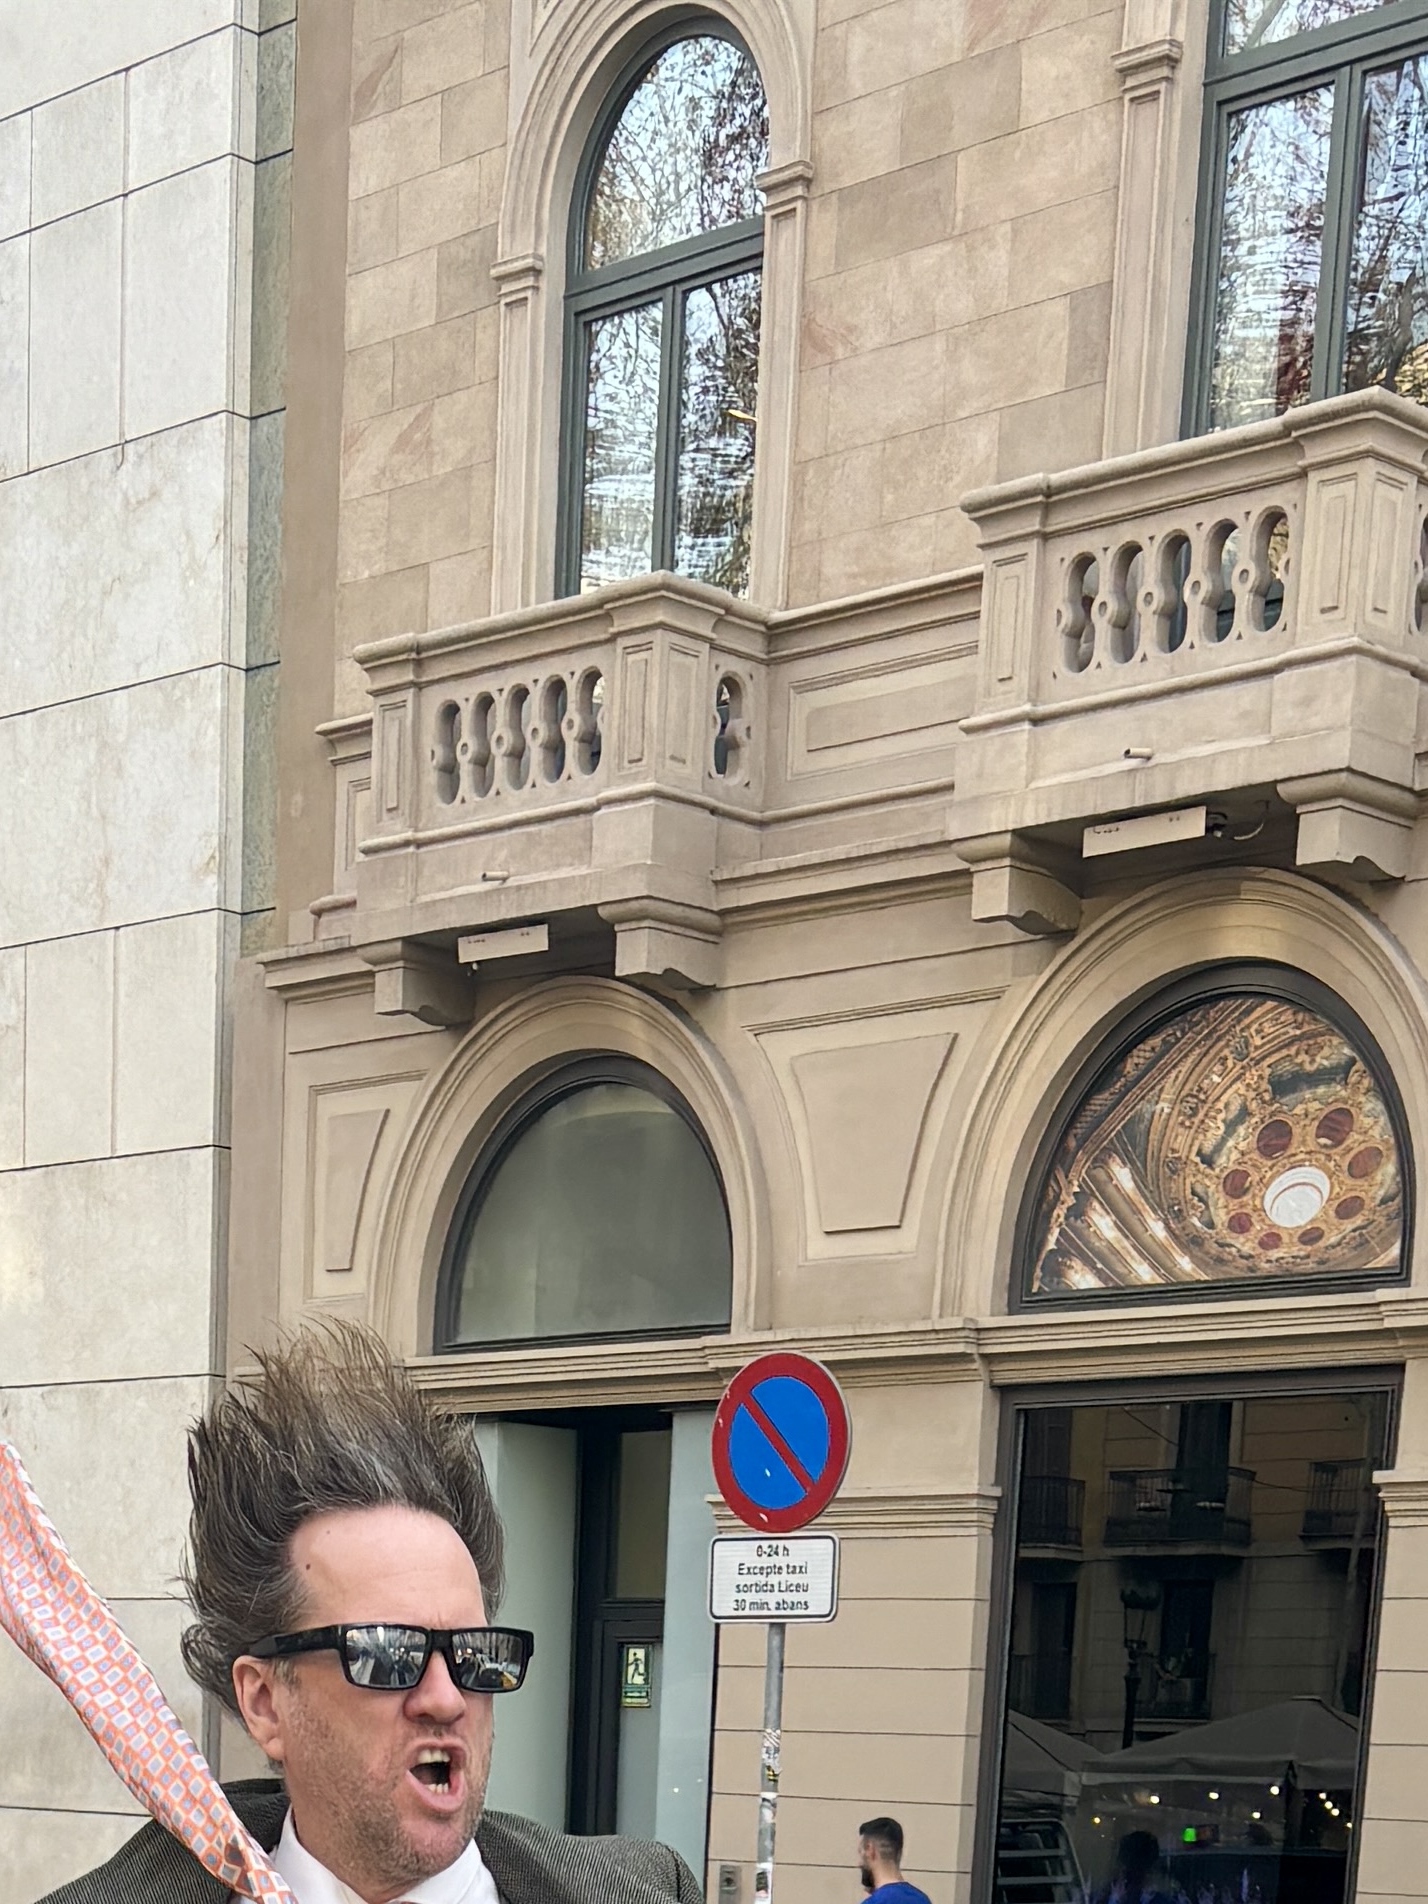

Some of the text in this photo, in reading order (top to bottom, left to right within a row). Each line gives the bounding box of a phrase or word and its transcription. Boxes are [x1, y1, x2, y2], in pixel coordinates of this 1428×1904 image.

[756, 1544, 790, 1557] 0-24 h
[737, 1561, 808, 1578] Excepte taxi
[735, 1580, 809, 1593] sortida Liceu
[733, 1599, 810, 1611] 30 min. abans
